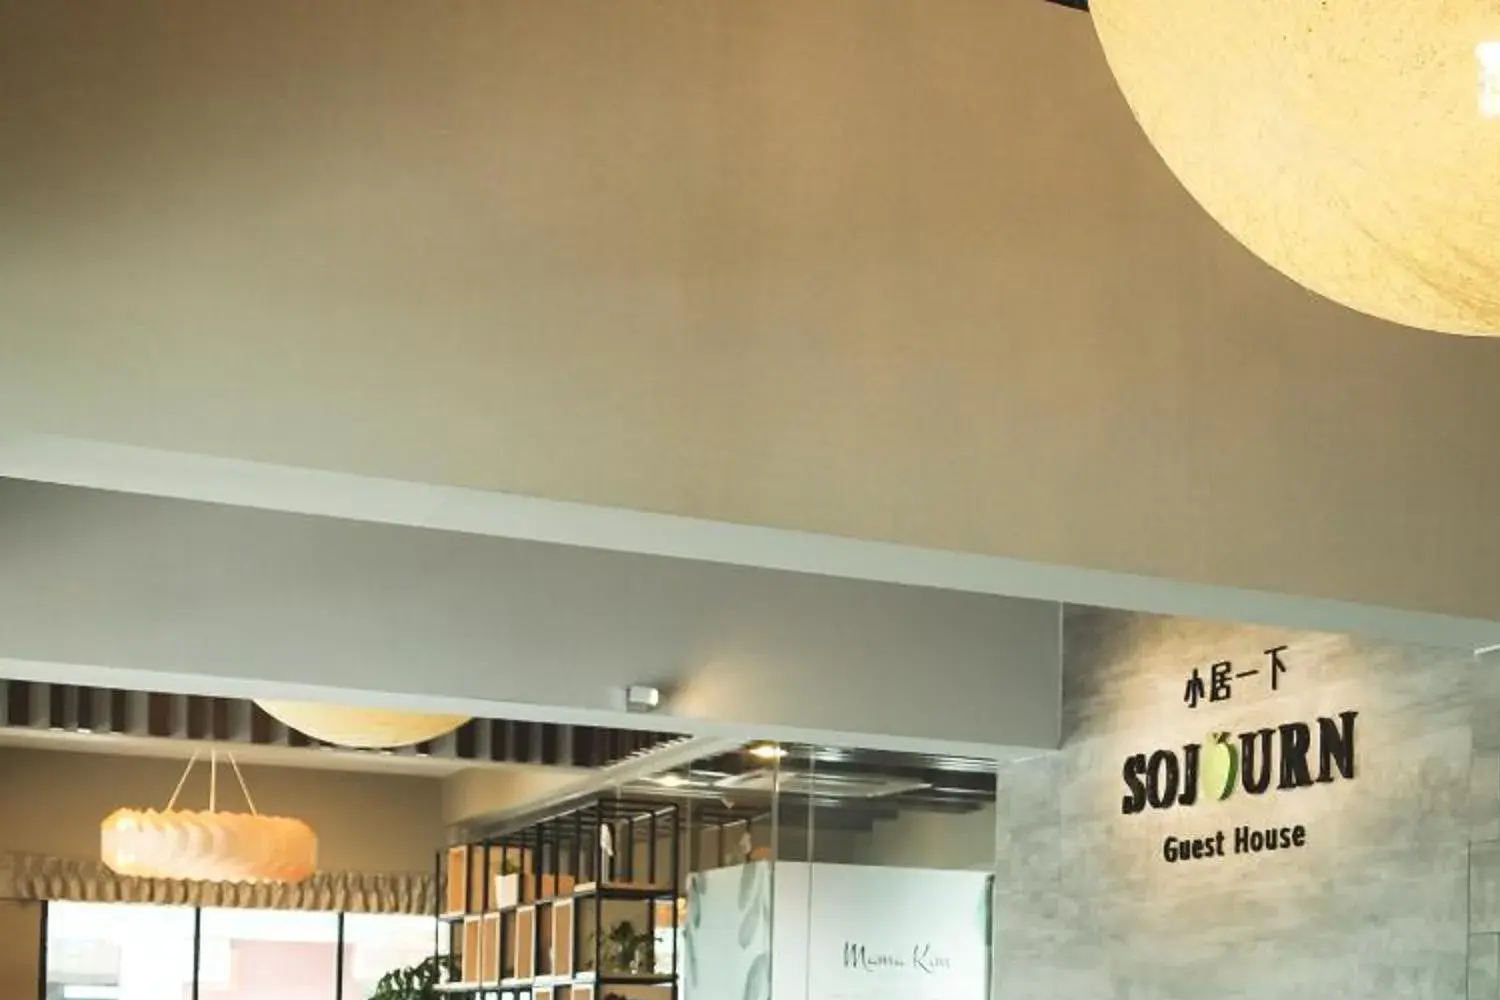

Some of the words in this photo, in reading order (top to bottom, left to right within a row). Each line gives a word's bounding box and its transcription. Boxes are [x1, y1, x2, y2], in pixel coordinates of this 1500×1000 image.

[1183, 645, 1289, 708] 小居一下
[1121, 710, 1359, 815] SOJOURN
[1163, 831, 1225, 863] Guest
[1234, 825, 1306, 855] House
